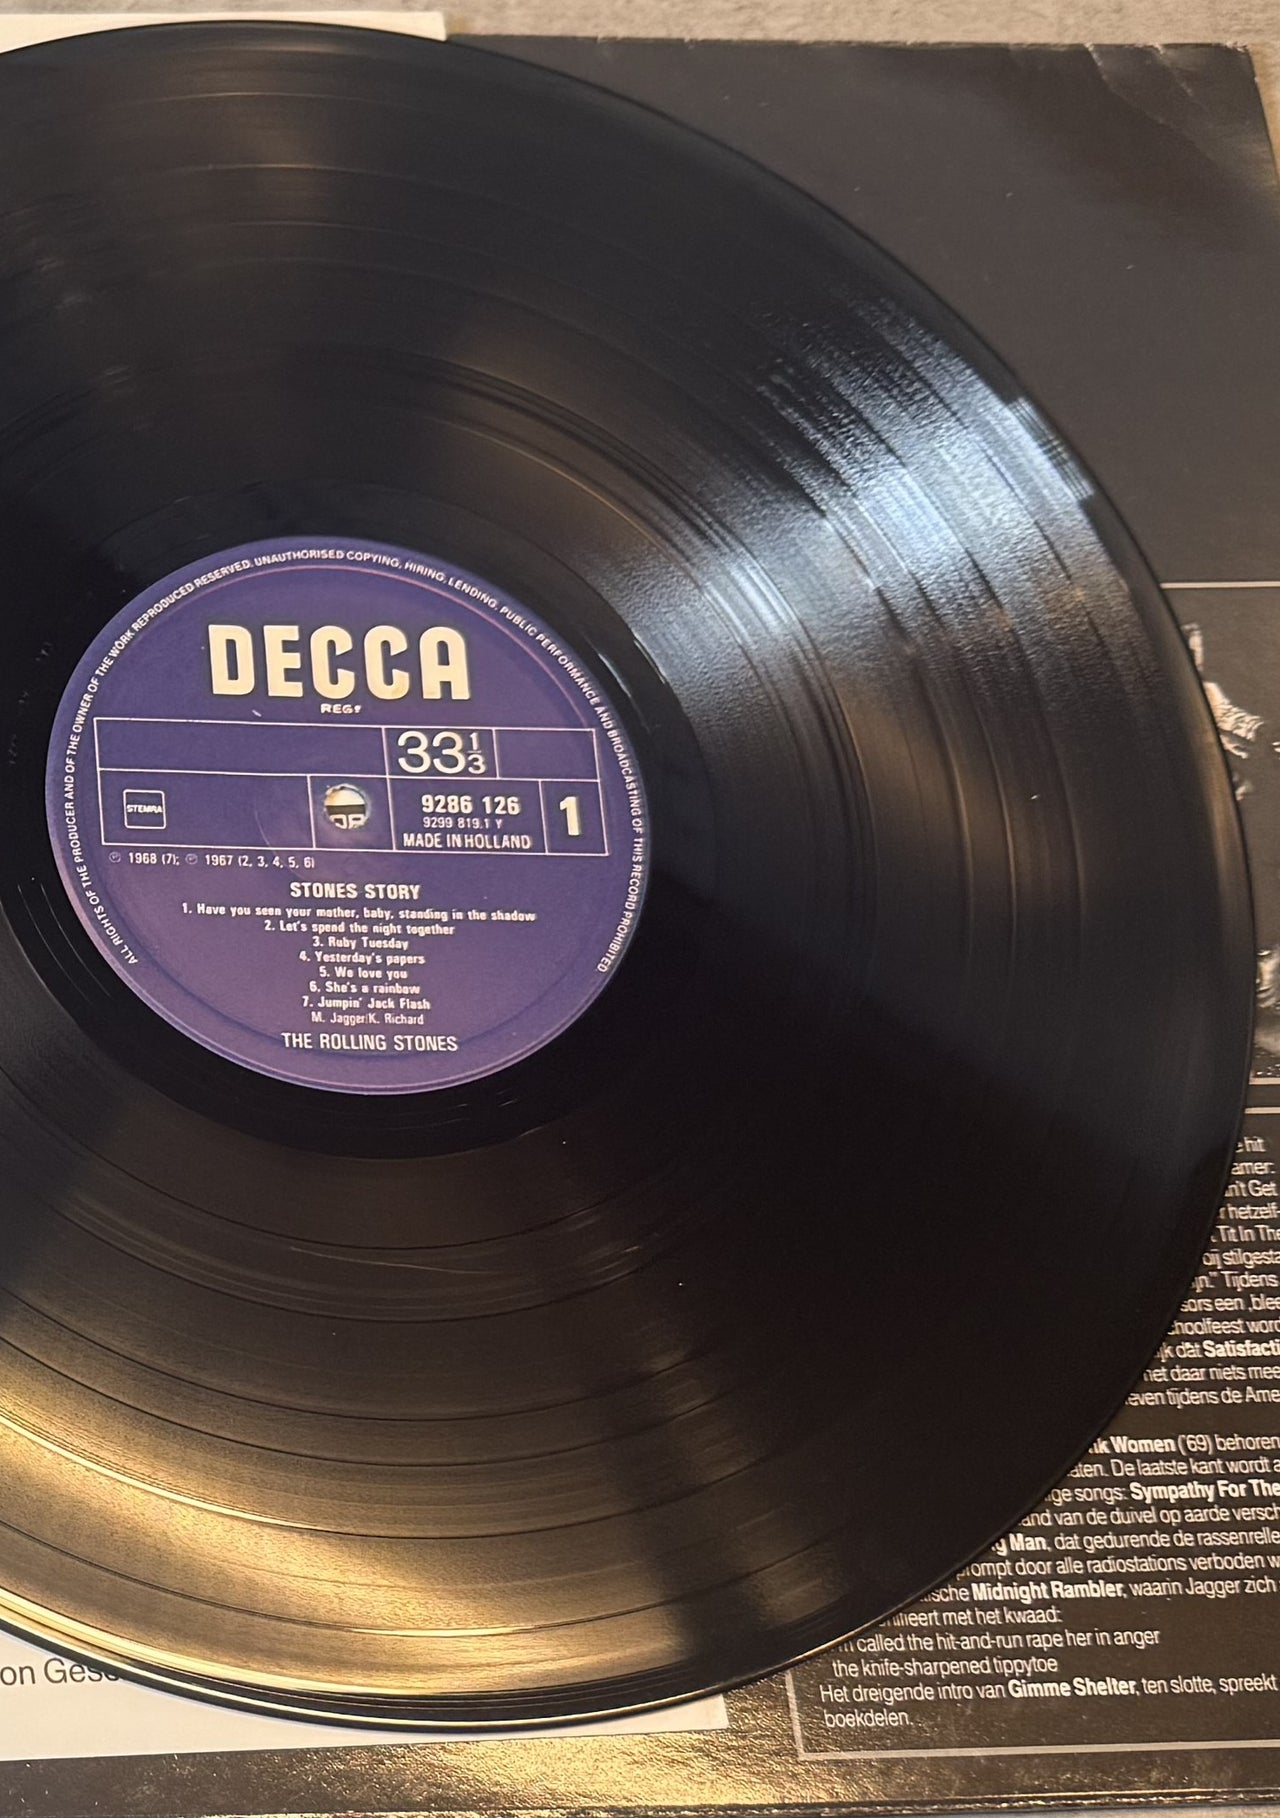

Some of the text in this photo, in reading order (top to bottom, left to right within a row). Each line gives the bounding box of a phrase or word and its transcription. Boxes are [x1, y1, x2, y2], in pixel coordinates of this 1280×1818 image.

[254, 549, 345, 567] UNAUTHORISED
[208, 624, 471, 700] DECCA
[421, 794, 521, 815] 9286 126
[422, 816, 503, 829] 9299 819.1 Y
[559, 797, 581, 836] 1
[403, 832, 532, 850] MADE IN HOLLAND
[289, 881, 421, 900] STONES STORY
[196, 902, 226, 915] Have
[229, 906, 251, 917] you
[255, 907, 282, 916] seen
[285, 907, 312, 919] your
[398, 908, 449, 922] standing
[451, 909, 464, 920] in
[467, 909, 487, 921] the
[490, 910, 536, 922] shadow
[328, 935, 357, 950] Ruby
[361, 936, 409, 951] Tuesday
[317, 995, 363, 1011] Jumpin'
[367, 997, 395, 1009] Jack
[399, 997, 431, 1010] Flash
[280, 1032, 459, 1052] THE ROLLING STONES
[972, 1581, 1049, 1601] Midnight
[1128, 1579, 1183, 1596] waarin
[1185, 1577, 1241, 1598] Jagger
[1244, 1575, 1278, 1594] zich
[832, 1656, 1058, 1679] the knife-sharpened tippytoe
[819, 1684, 851, 1703] Het
[852, 1682, 935, 1706] dreigende
[936, 1681, 974, 1700] intro
[975, 1684, 1007, 1699] van
[1007, 1679, 1072, 1698] Gimme
[1141, 1678, 1169, 1695] ten
[1219, 1672, 1279, 1696] spreekt
